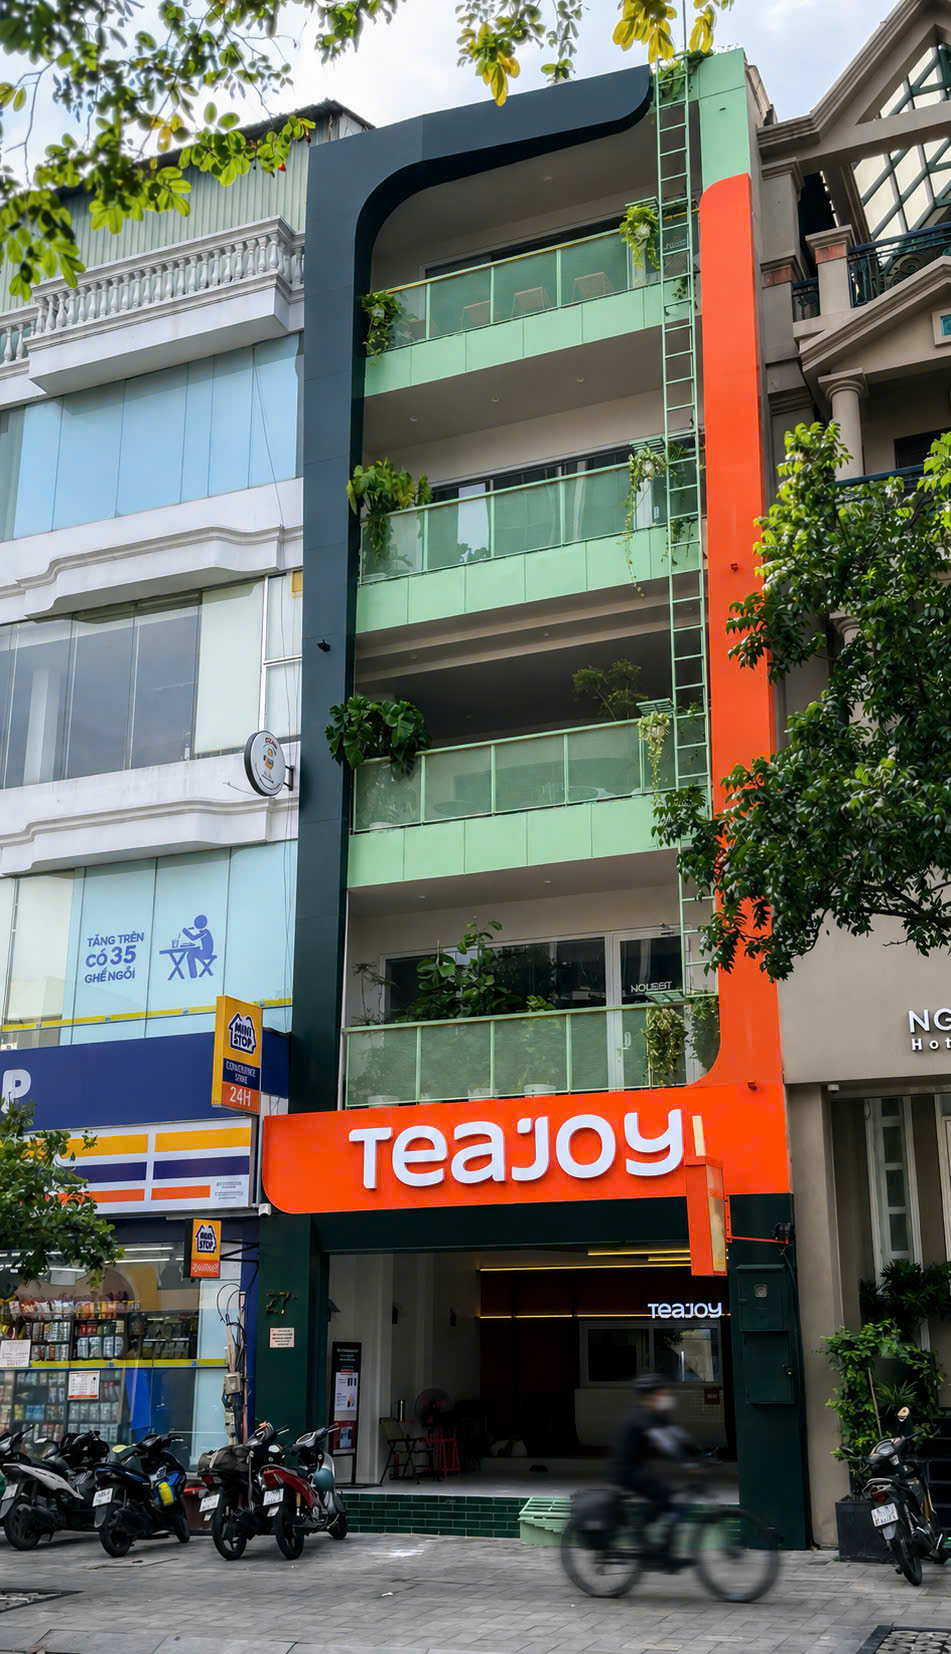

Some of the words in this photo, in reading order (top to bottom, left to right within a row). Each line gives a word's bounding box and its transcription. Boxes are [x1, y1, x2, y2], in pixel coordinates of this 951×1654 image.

[85, 948, 108, 967] CÓ
[110, 944, 137, 965] 35
[234, 1033, 252, 1049] STOP
[230, 1086, 252, 1107] 24H
